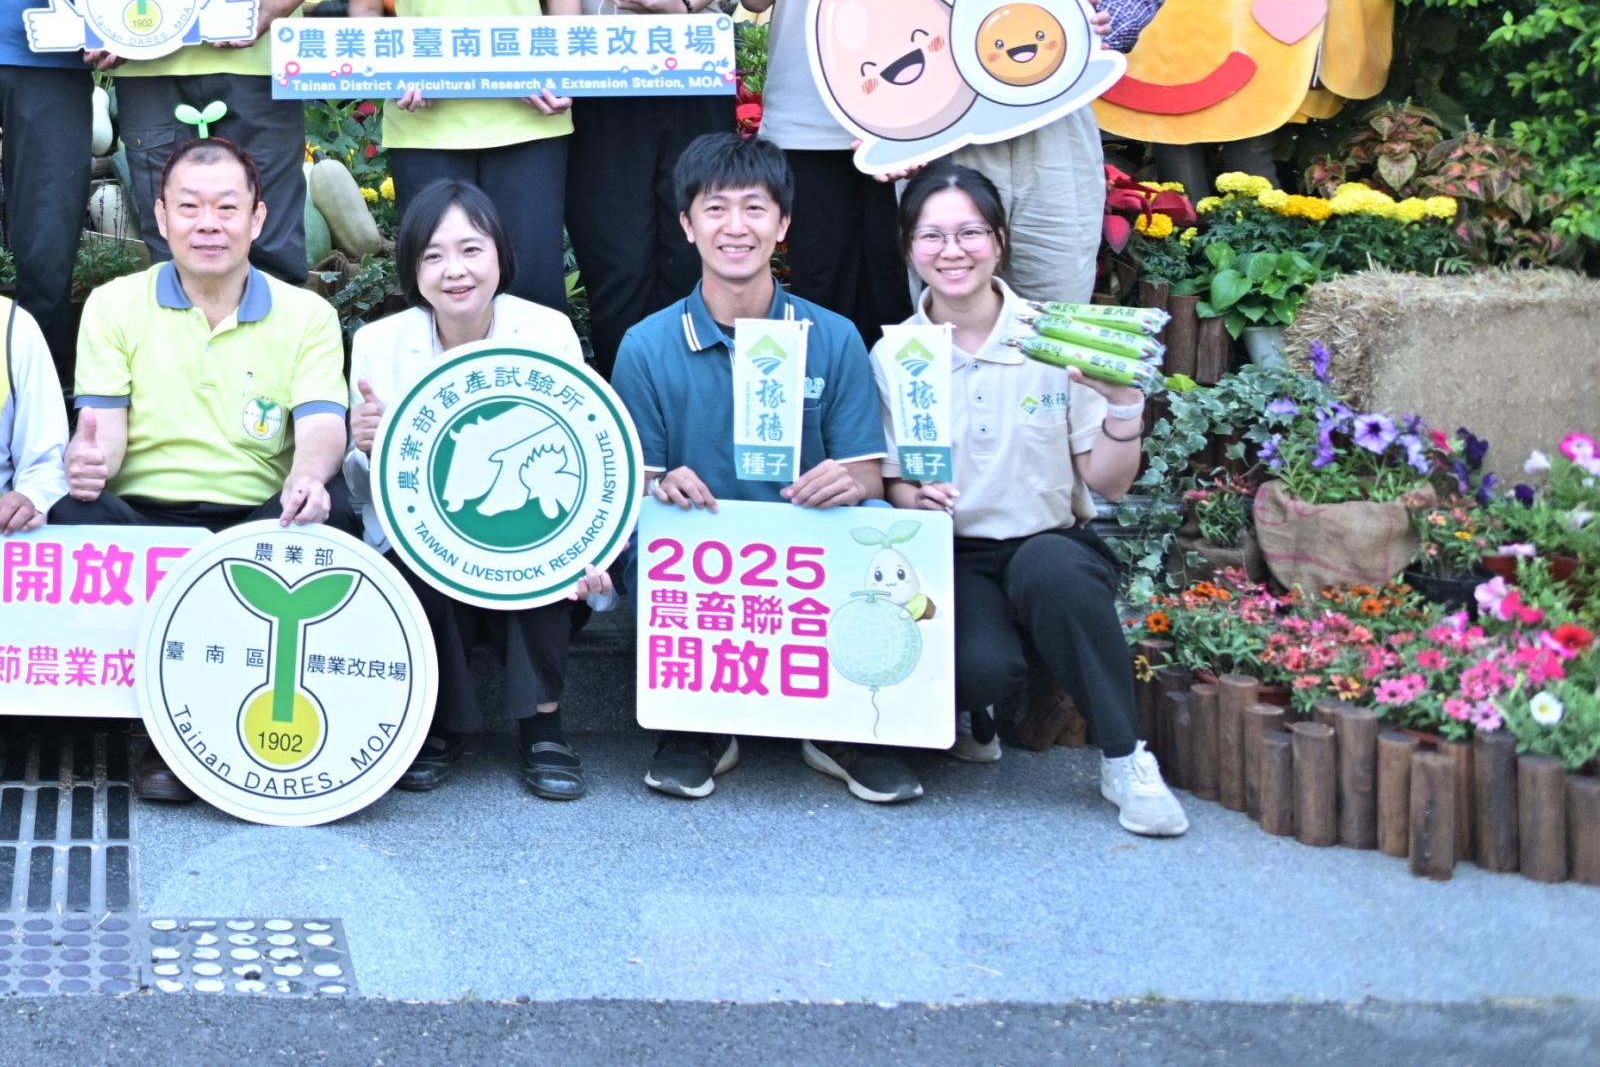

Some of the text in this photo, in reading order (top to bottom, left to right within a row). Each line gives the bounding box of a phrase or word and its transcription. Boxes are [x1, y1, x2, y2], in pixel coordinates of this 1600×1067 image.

[132, 19, 153, 29] 1902
[296, 25, 717, 59] 農業部臺南區農業改良場
[292, 76, 724, 92] Tainan District Agricultural Research & Extension Station, MOA
[397, 366, 586, 494] 農業部畜產試驗所
[742, 452, 788, 476] 種子
[904, 452, 946, 476] 種子
[414, 429, 616, 582] TAIWAN LIVESTOCK RESEARCH INSTITUTE
[254, 542, 334, 567] 農業部
[647, 537, 827, 590] 2025
[649, 589, 831, 637] 農畜聯合
[165, 640, 408, 682] 臺南區 農業改良場
[648, 635, 830, 699] 開放日
[174, 704, 232, 778] Tainan
[350, 720, 397, 772] MOA
[258, 731, 304, 753] 1902
